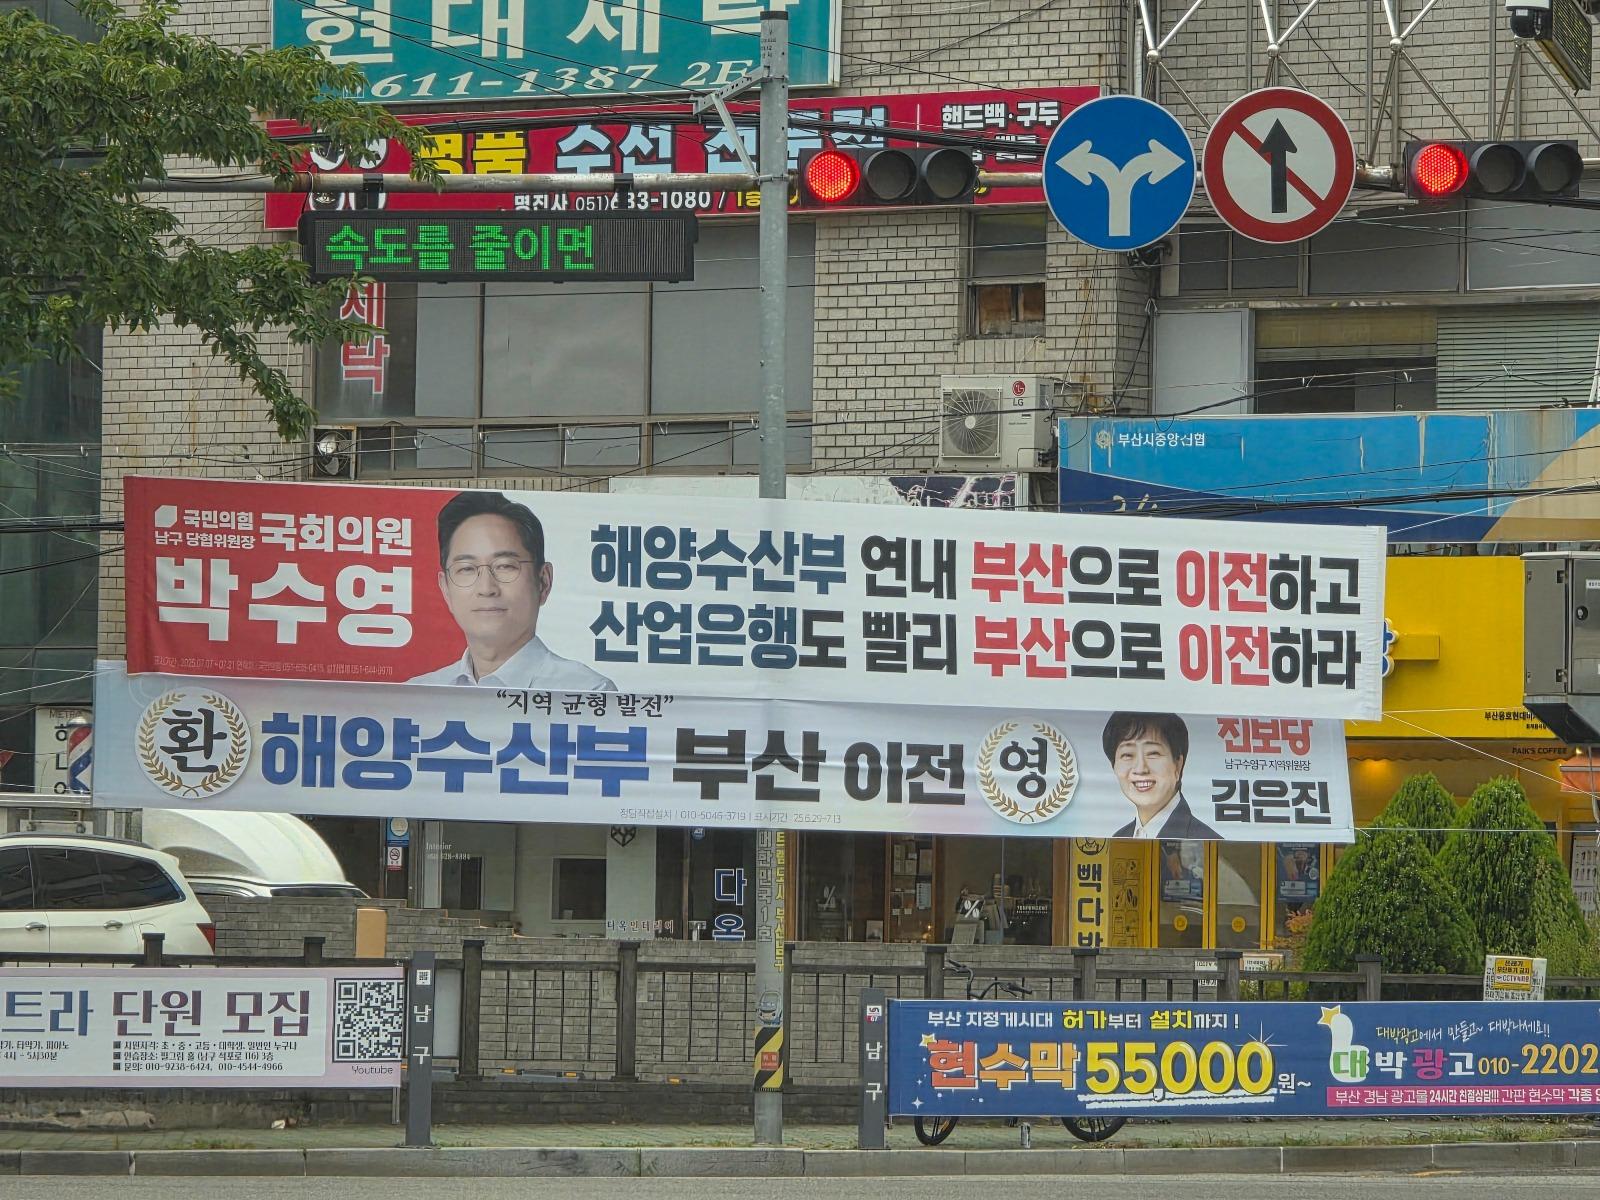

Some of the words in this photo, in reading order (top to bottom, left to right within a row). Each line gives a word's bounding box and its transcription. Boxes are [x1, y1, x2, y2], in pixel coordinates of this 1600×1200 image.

[326, 225, 455, 270] 속도를
[468, 225, 595, 270] 줄이면
[1013, 398, 1024, 406] LG
[155, 530, 183, 546] 남구
[186, 532, 256, 550] 당협위원장
[183, 509, 255, 532] 국민의힘
[260, 512, 412, 557] 국회의원
[591, 523, 847, 595] 해양수산부
[860, 535, 957, 600] 연내
[971, 541, 1162, 607] 부산으로
[1176, 549, 1361, 615] 이전하고
[154, 556, 413, 648] 박수영
[589, 600, 847, 670] 산업은행도
[862, 610, 958, 675] 빨리
[973, 616, 1165, 681] 부산으로
[1178, 623, 1361, 690] 이전하라
[561, 692, 606, 717] 균형
[160, 707, 227, 774] 환
[261, 711, 650, 798] 해양수산부
[673, 727, 827, 802] 부산
[844, 741, 965, 805] 이전
[1216, 717, 1314, 756] 진보당
[999, 736, 1048, 799] 영
[1212, 779, 1332, 825] 김은진
[113, 990, 201, 1036] 단원
[223, 990, 310, 1036] 모집
[928, 1011, 962, 1028] 부산
[966, 1011, 1053, 1029] 지정게시대
[1062, 1009, 1142, 1030] 허가부터
[1149, 1009, 1228, 1030] 설치까지
[1375, 1026, 1443, 1045] 대박광고에서
[218, 1062, 283, 1071] 010-4544-4966
[352, 1065, 394, 1075] Youtube
[926, 1039, 1081, 1091] 현수막
[1332, 1048, 1475, 1080] 대박광고
[1335, 1089, 1360, 1105] 부산
[1364, 1089, 1388, 1104] 경남
[1429, 1089, 1457, 1104] 24시간
[1502, 1088, 1526, 1103] 간판
[1529, 1087, 1565, 1102] 현수막
[1568, 1087, 1592, 1102] 각종
